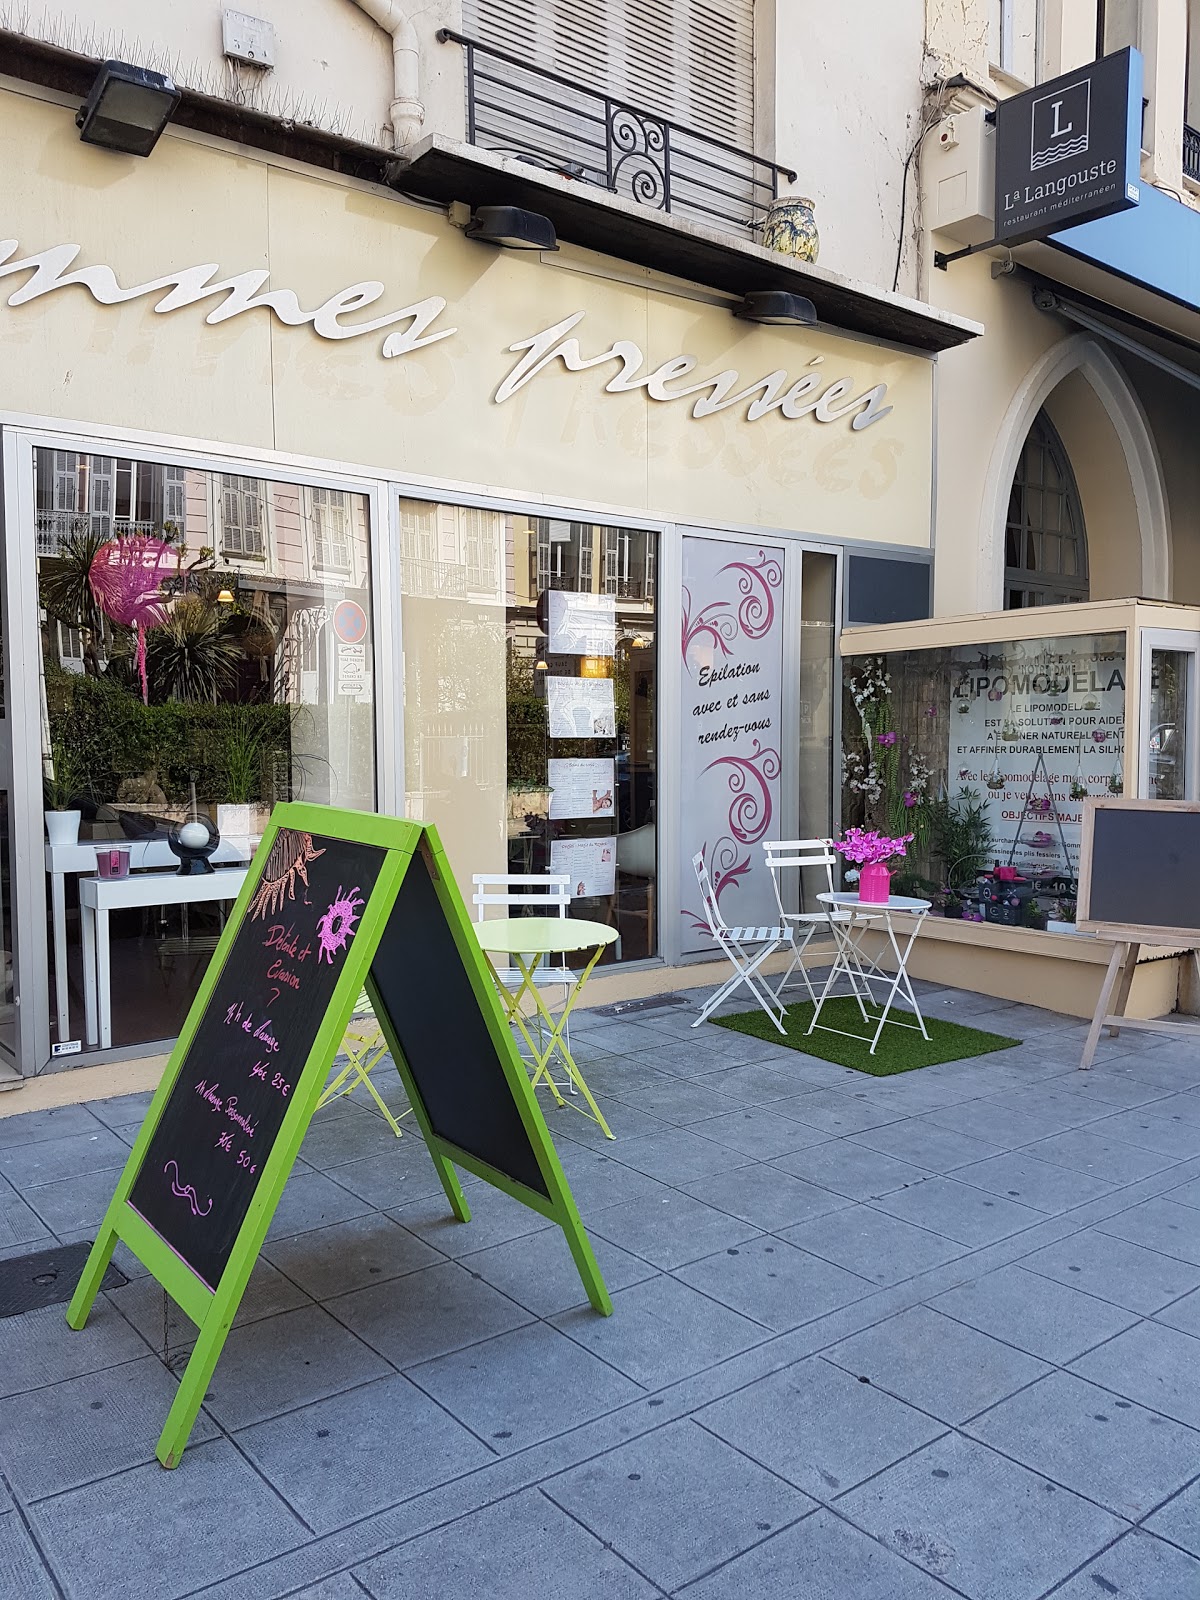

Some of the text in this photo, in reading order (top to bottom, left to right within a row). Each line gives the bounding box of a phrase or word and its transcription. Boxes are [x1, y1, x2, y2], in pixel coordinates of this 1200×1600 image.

[1050, 100, 1073, 138] L
[1004, 190, 1020, 211] La
[1024, 159, 1117, 204] Langouste
[1003, 206, 1047, 227] restaurant
[1050, 183, 1116, 211] méditerranéen
[494, 310, 894, 431] pressées
[698, 663, 760, 687] Epilation
[692, 689, 771, 716] avec et sans
[698, 717, 772, 744] rendez-vous
[985, 718, 1001, 727] EST
[1018, 717, 1065, 727] SOLUTN
[1069, 716, 1096, 726] POUR
[1041, 731, 1124, 740] NATURELLENT
[957, 746, 967, 754] ET
[969, 746, 1007, 754] AFFINER
[1009, 746, 1080, 754] DURABLEMENT
[1083, 746, 1096, 754] LA
[980, 769, 989, 781] le
[1088, 774, 1111, 786] corp
[1001, 787, 1012, 802] je
[1044, 793, 1066, 801] sans
[1001, 810, 1054, 821] OBJECTIFS
[1036, 850, 1061, 859] fessiers
[241, 1013, 253, 1032] de
